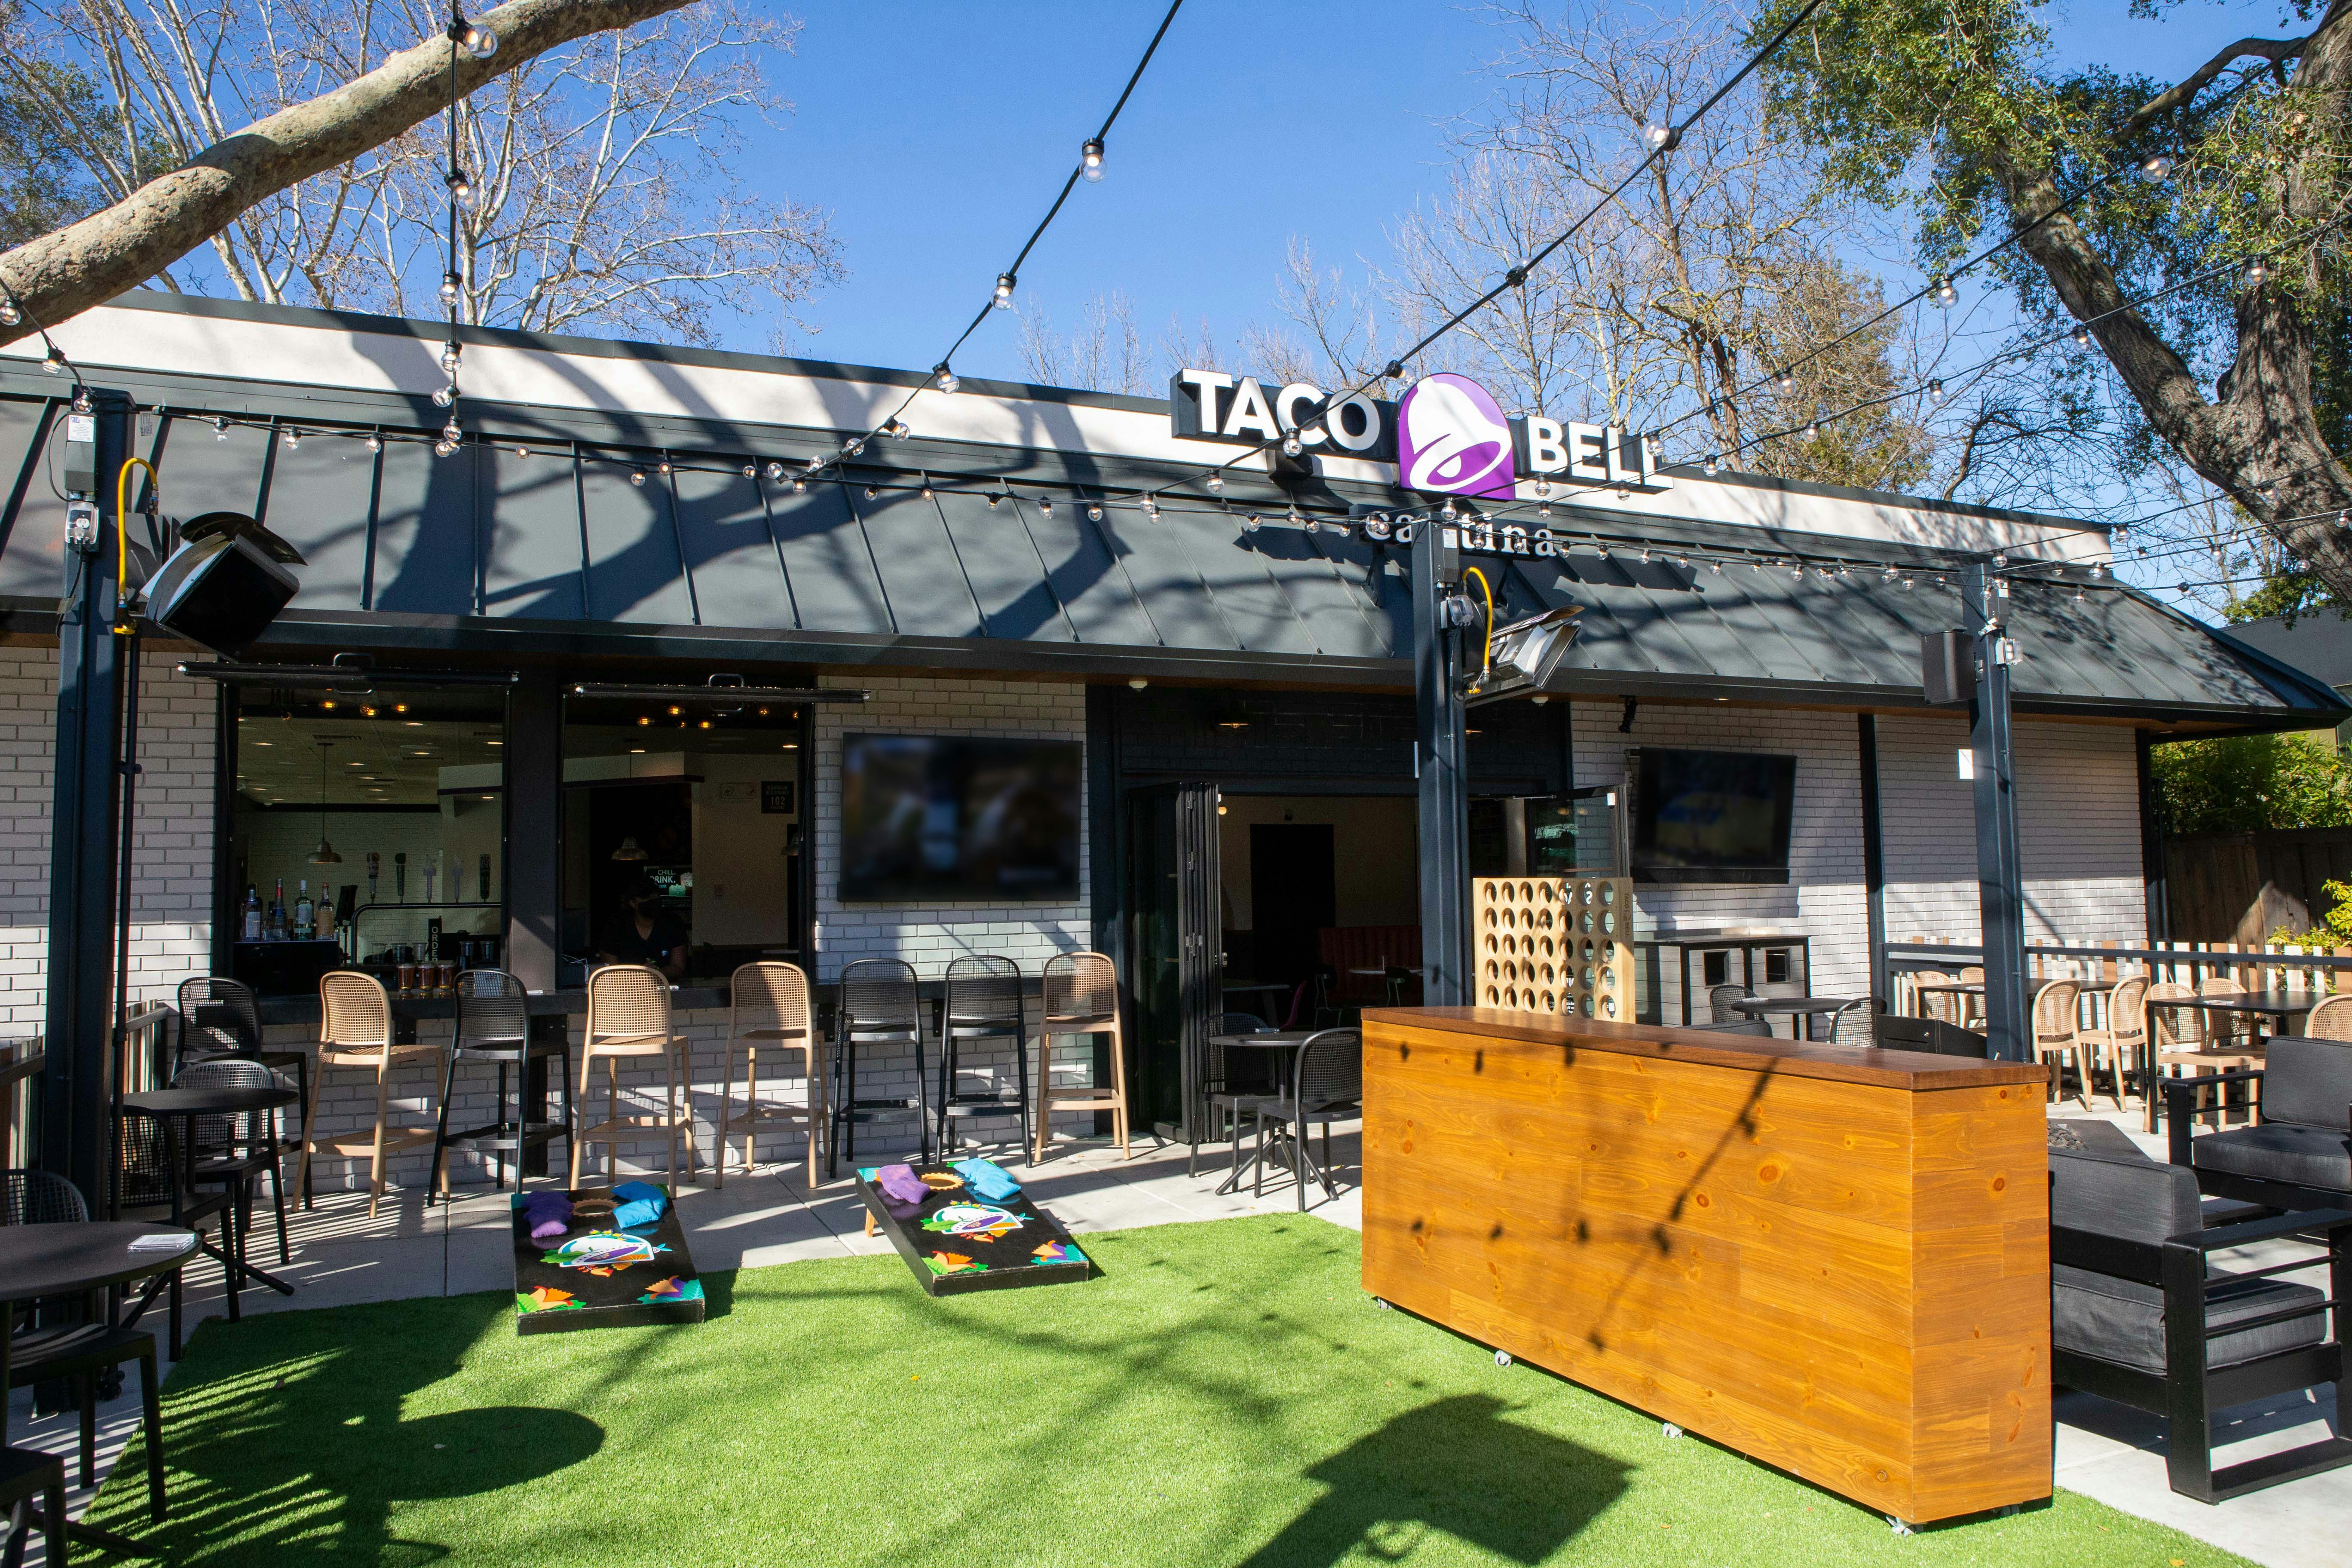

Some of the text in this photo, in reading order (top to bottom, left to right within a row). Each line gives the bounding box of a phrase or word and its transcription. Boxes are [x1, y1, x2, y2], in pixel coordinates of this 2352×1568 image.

[1182, 368, 1674, 489] TACO BELL
[1366, 511, 1557, 557] catina
[770, 796, 785, 805] 102
